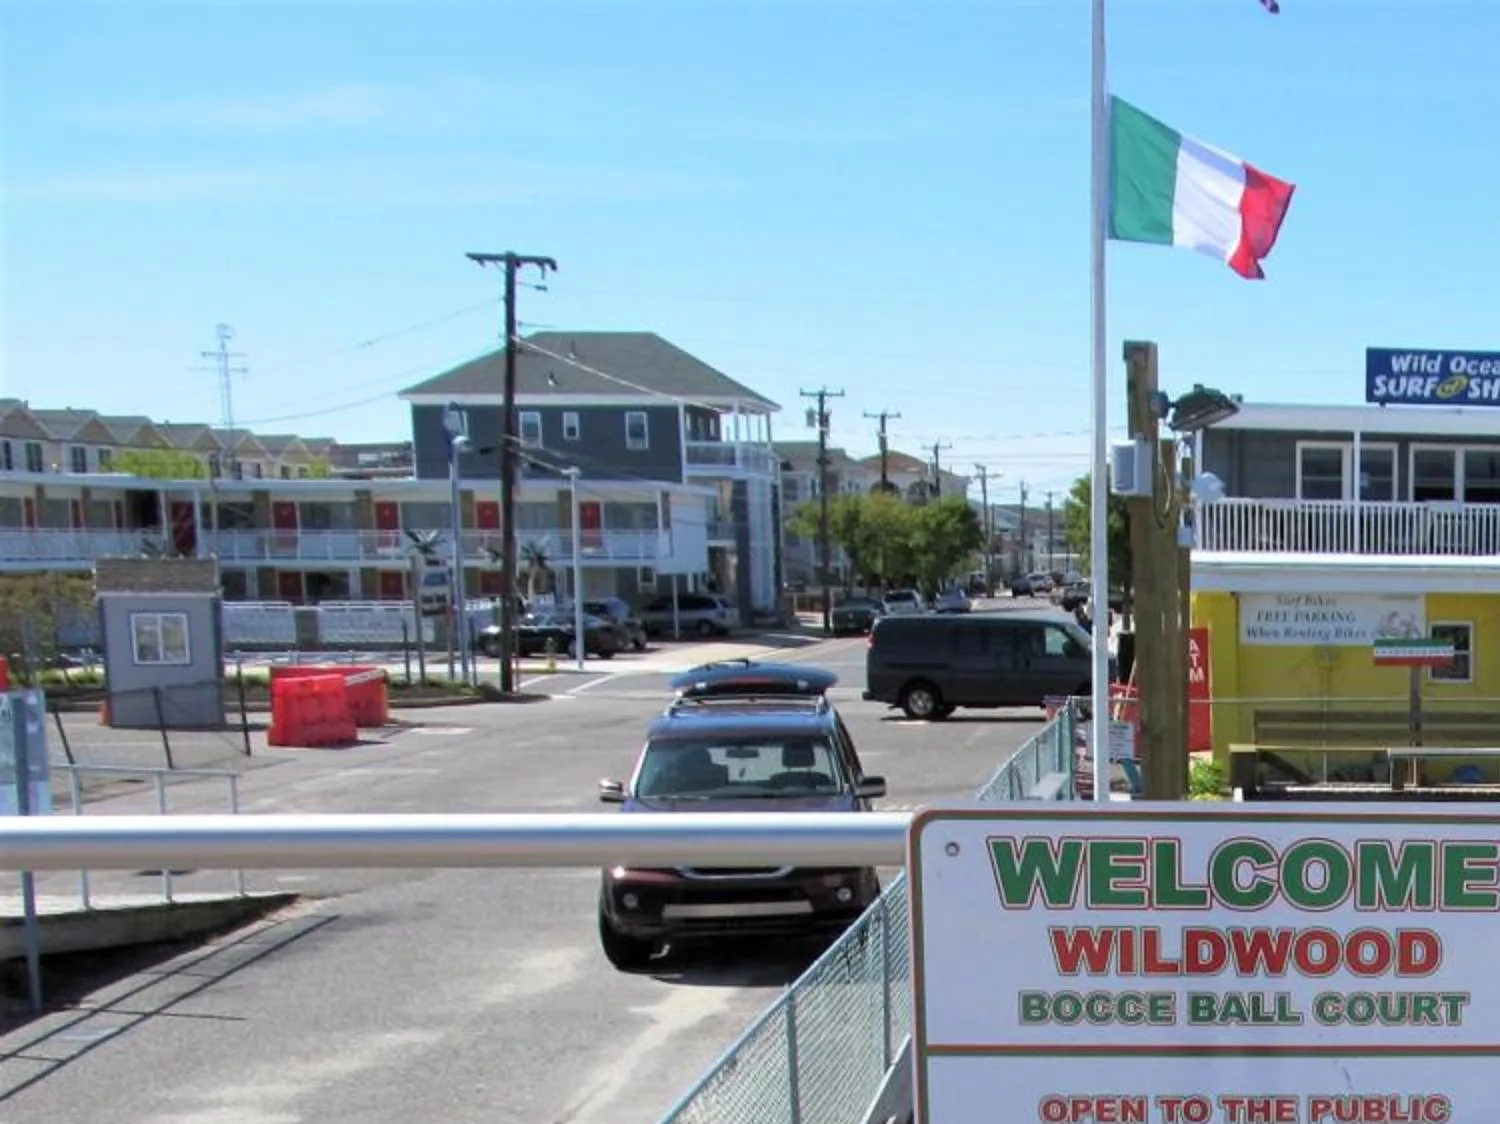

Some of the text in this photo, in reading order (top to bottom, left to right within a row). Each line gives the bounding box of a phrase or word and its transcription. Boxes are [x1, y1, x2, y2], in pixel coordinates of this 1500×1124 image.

[1391, 353, 1442, 373] Wild
[1373, 375, 1439, 398] SURF
[1256, 610, 1357, 623] FREE PARKING
[1247, 626, 1281, 638] When
[1189, 639, 1204, 683] ATM
[1049, 925, 1443, 977] WILDWOOD
[1018, 990, 1470, 1025] BOCCE BALL COURT
[1308, 1093, 1451, 1124] PUBLIC
